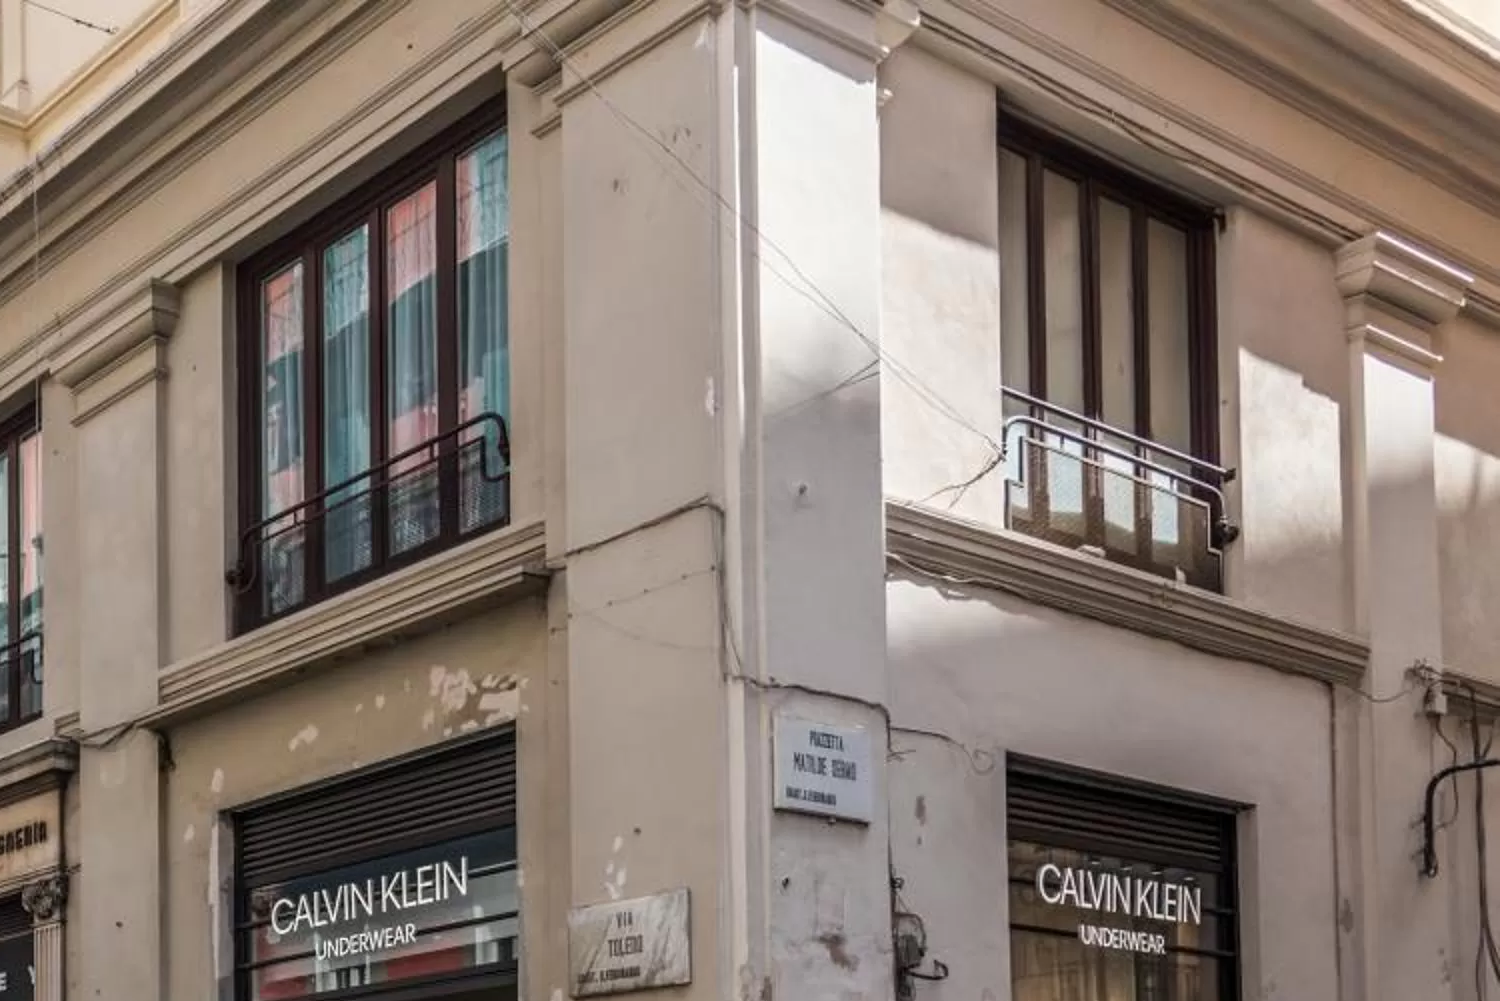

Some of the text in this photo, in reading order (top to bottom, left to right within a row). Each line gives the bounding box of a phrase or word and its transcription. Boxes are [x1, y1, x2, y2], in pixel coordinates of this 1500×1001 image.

[271, 856, 468, 935] CALVIN KLEIN
[1038, 863, 1201, 925] CALVIN KLEIN
[314, 923, 417, 960] UNDERWEAR
[1077, 924, 1167, 955] UNDERWEAR
